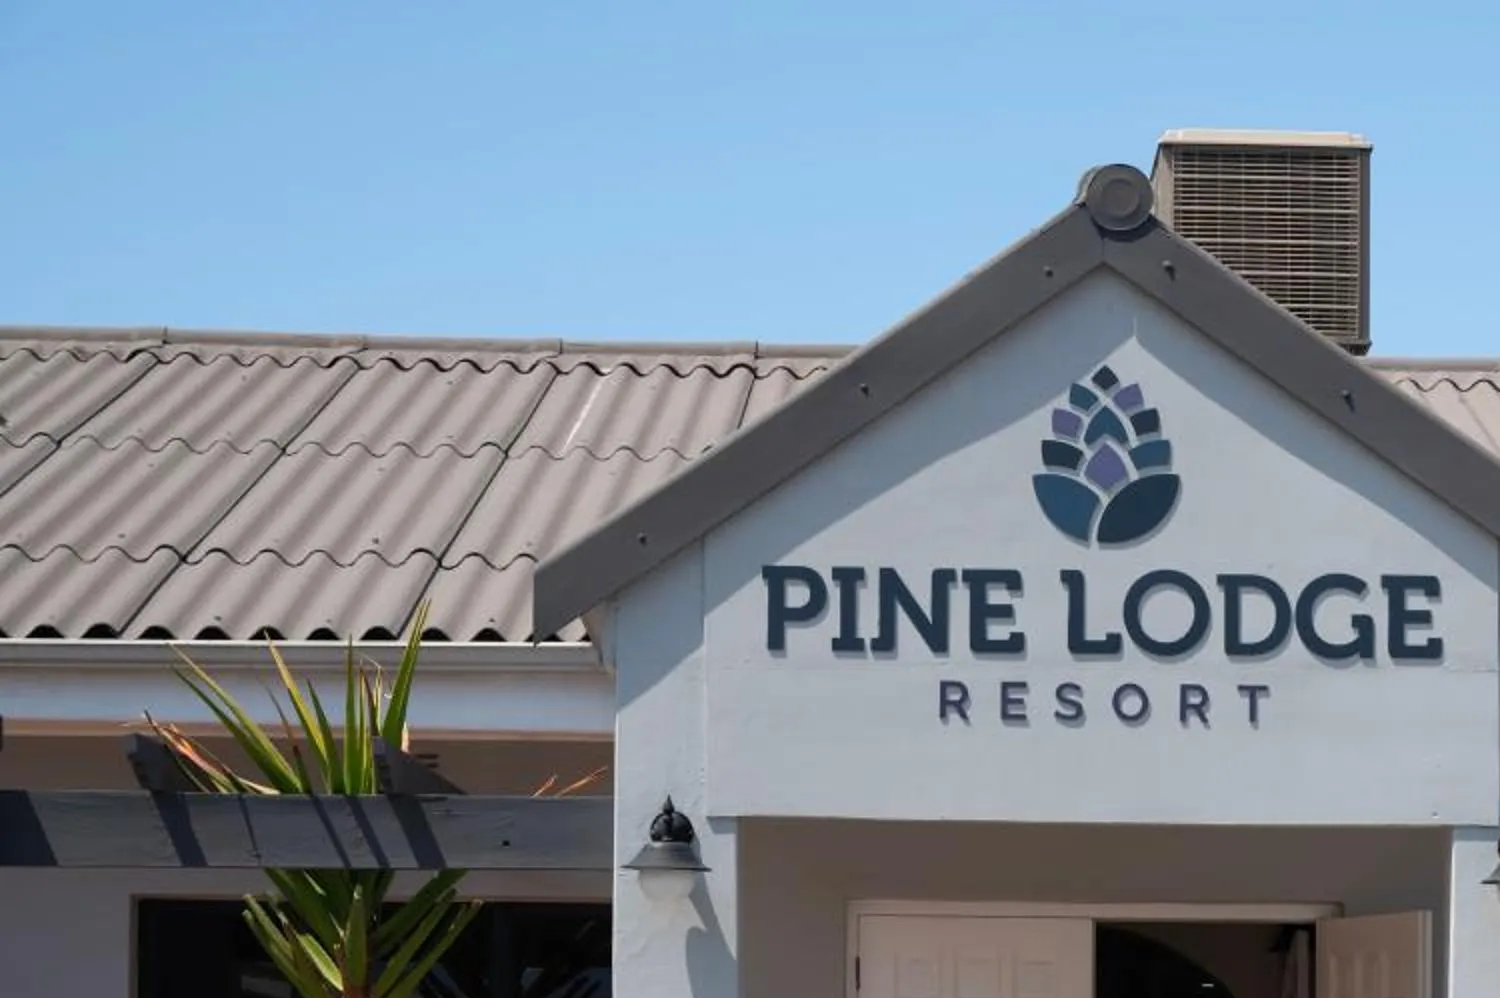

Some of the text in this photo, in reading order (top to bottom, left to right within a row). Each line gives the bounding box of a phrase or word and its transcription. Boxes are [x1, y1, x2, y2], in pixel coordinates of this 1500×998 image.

[762, 565, 1444, 660] PINE LODGE
[939, 681, 1271, 725] RESORT
